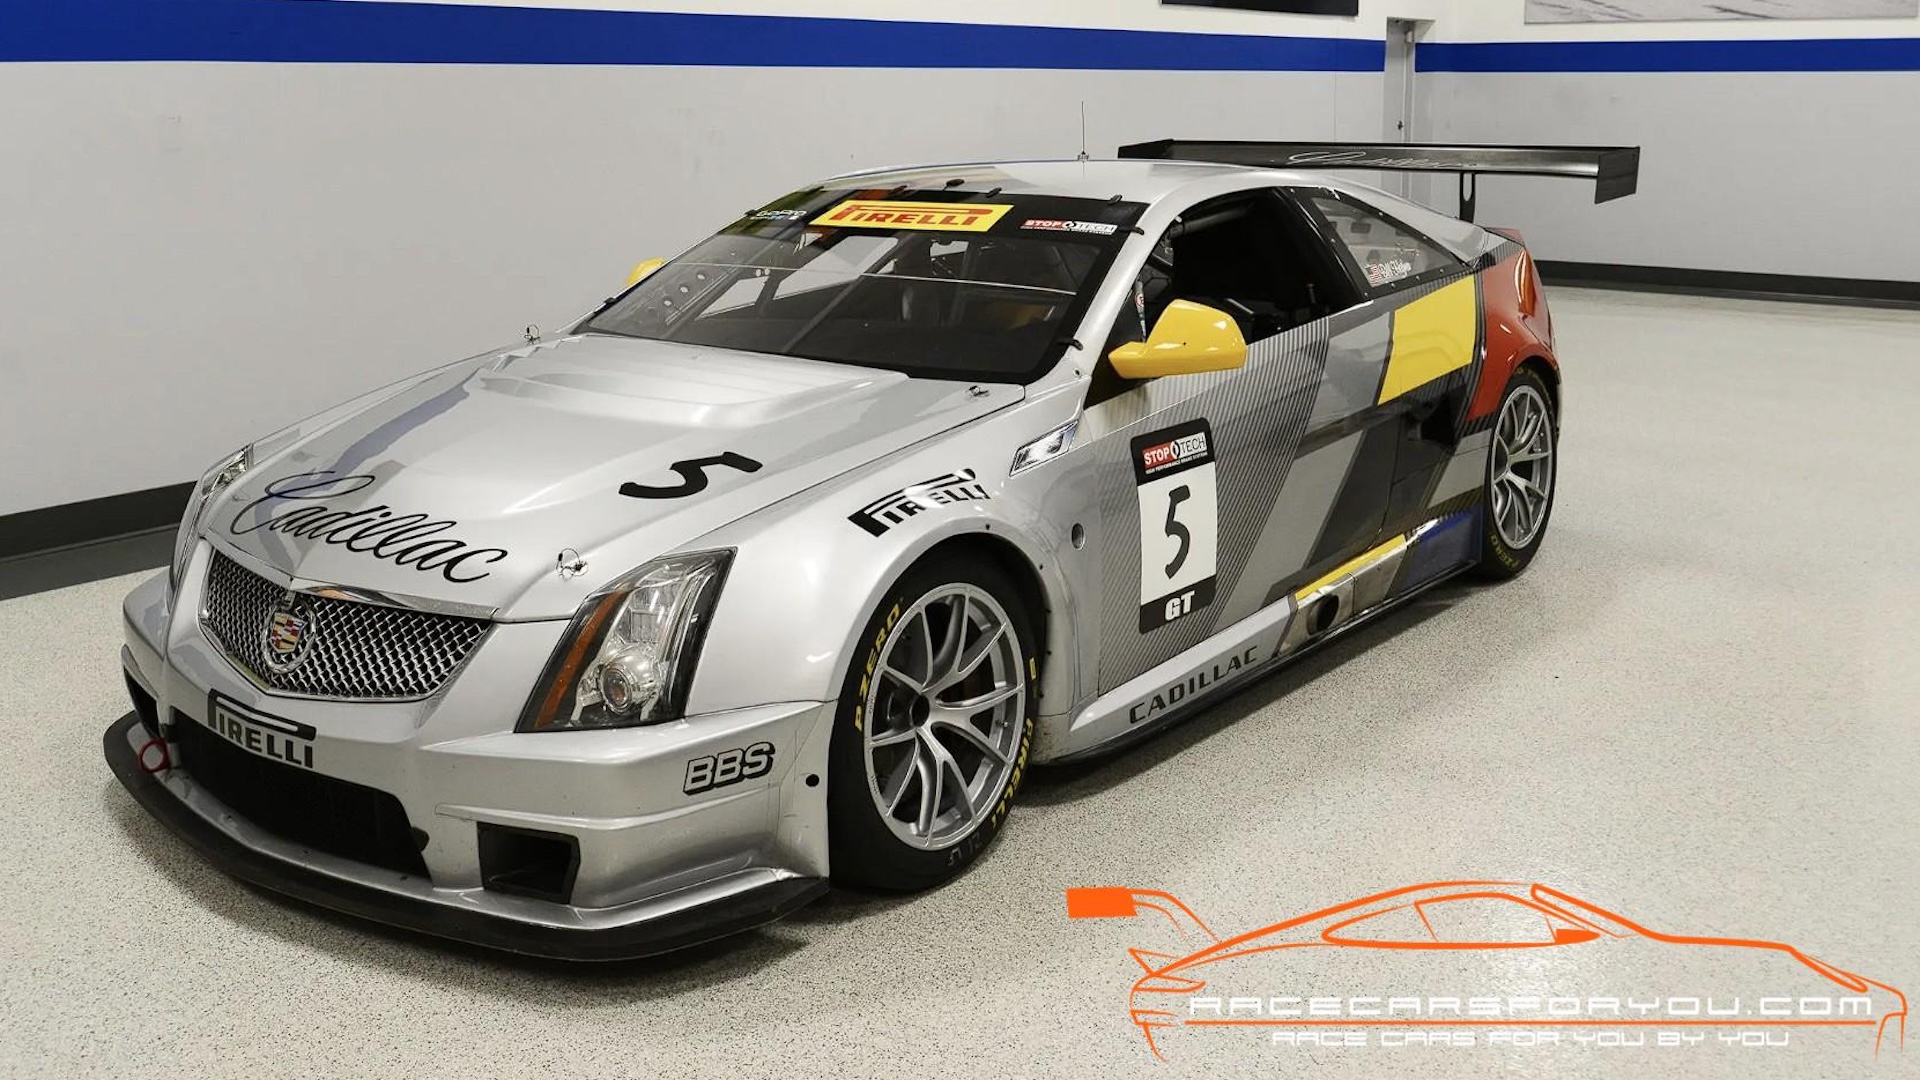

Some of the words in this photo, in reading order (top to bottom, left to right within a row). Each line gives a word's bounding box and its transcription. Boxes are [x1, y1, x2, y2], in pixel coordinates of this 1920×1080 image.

[828, 203, 994, 226] PIRELLI
[618, 451, 763, 499] 5
[1143, 448, 1170, 465] STOP
[1180, 437, 1206, 454] TECH
[230, 471, 508, 583] Cadillac
[848, 468, 991, 537] PIRELLI
[1164, 484, 1191, 580] 5
[1164, 590, 1195, 622] GT
[860, 602, 900, 703] ZERO
[1129, 645, 1260, 725] CADILLAC
[208, 688, 317, 769] PIRELLI
[683, 741, 775, 795] BBS
